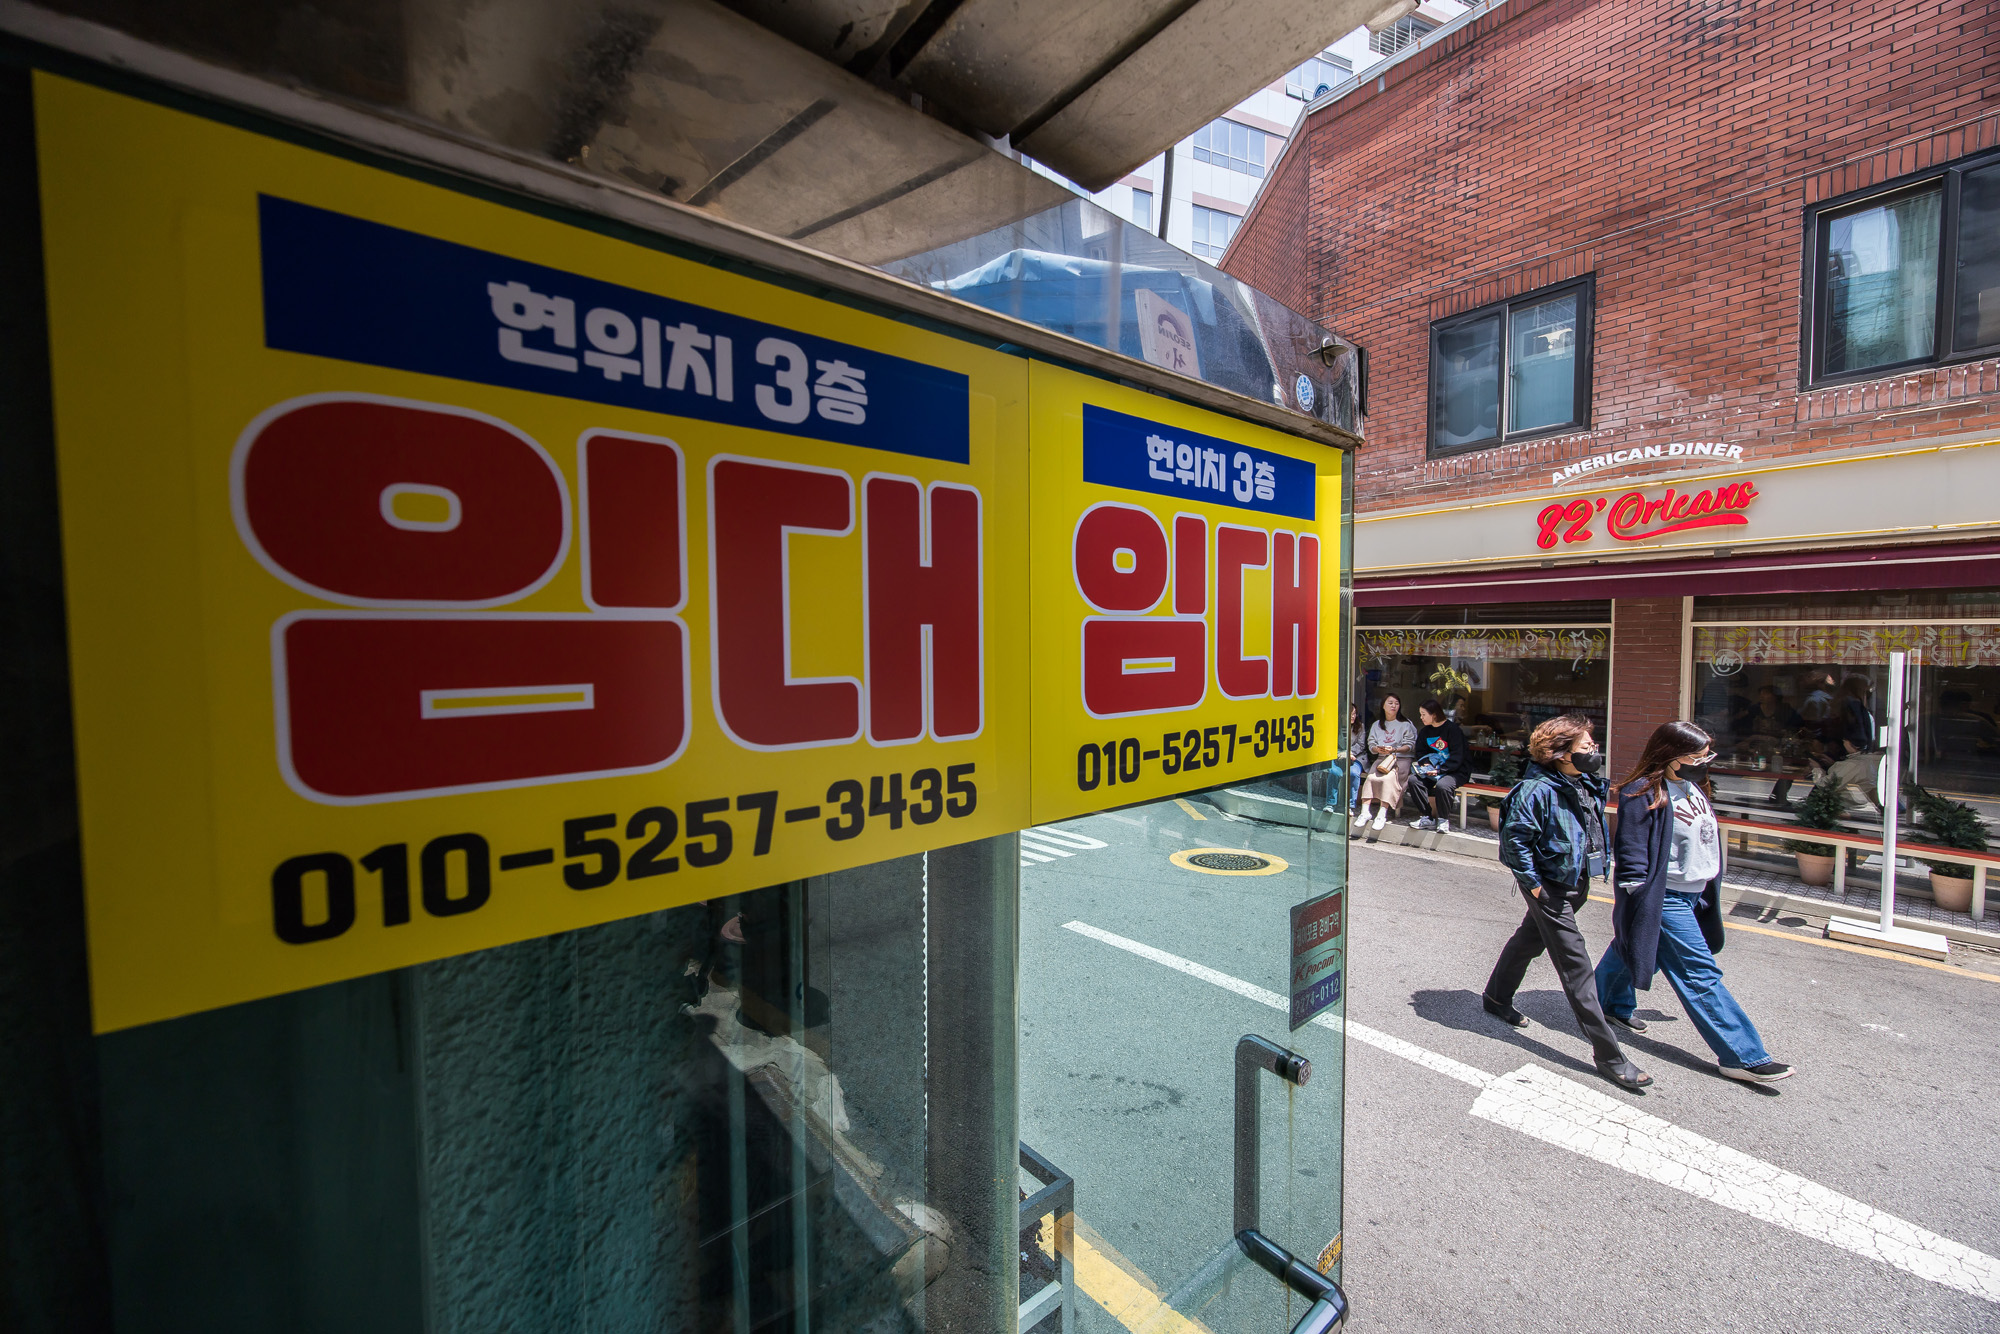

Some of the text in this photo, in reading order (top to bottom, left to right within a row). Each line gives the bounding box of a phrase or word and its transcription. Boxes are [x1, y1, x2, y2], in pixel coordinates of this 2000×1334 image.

[487, 280, 869, 426] 현위치 3층
[1146, 433, 1276, 503] 현위치 3층
[1552, 442, 1744, 485] AMERICAN DINER
[1607, 481, 1759, 541] Orleans
[229, 391, 984, 806] 임대
[1072, 500, 1320, 719] 임대
[1077, 713, 1315, 793] 010-5257-3435
[271, 762, 979, 946] 010-5257-3435
[1319, 910, 1340, 937] 경비구역
